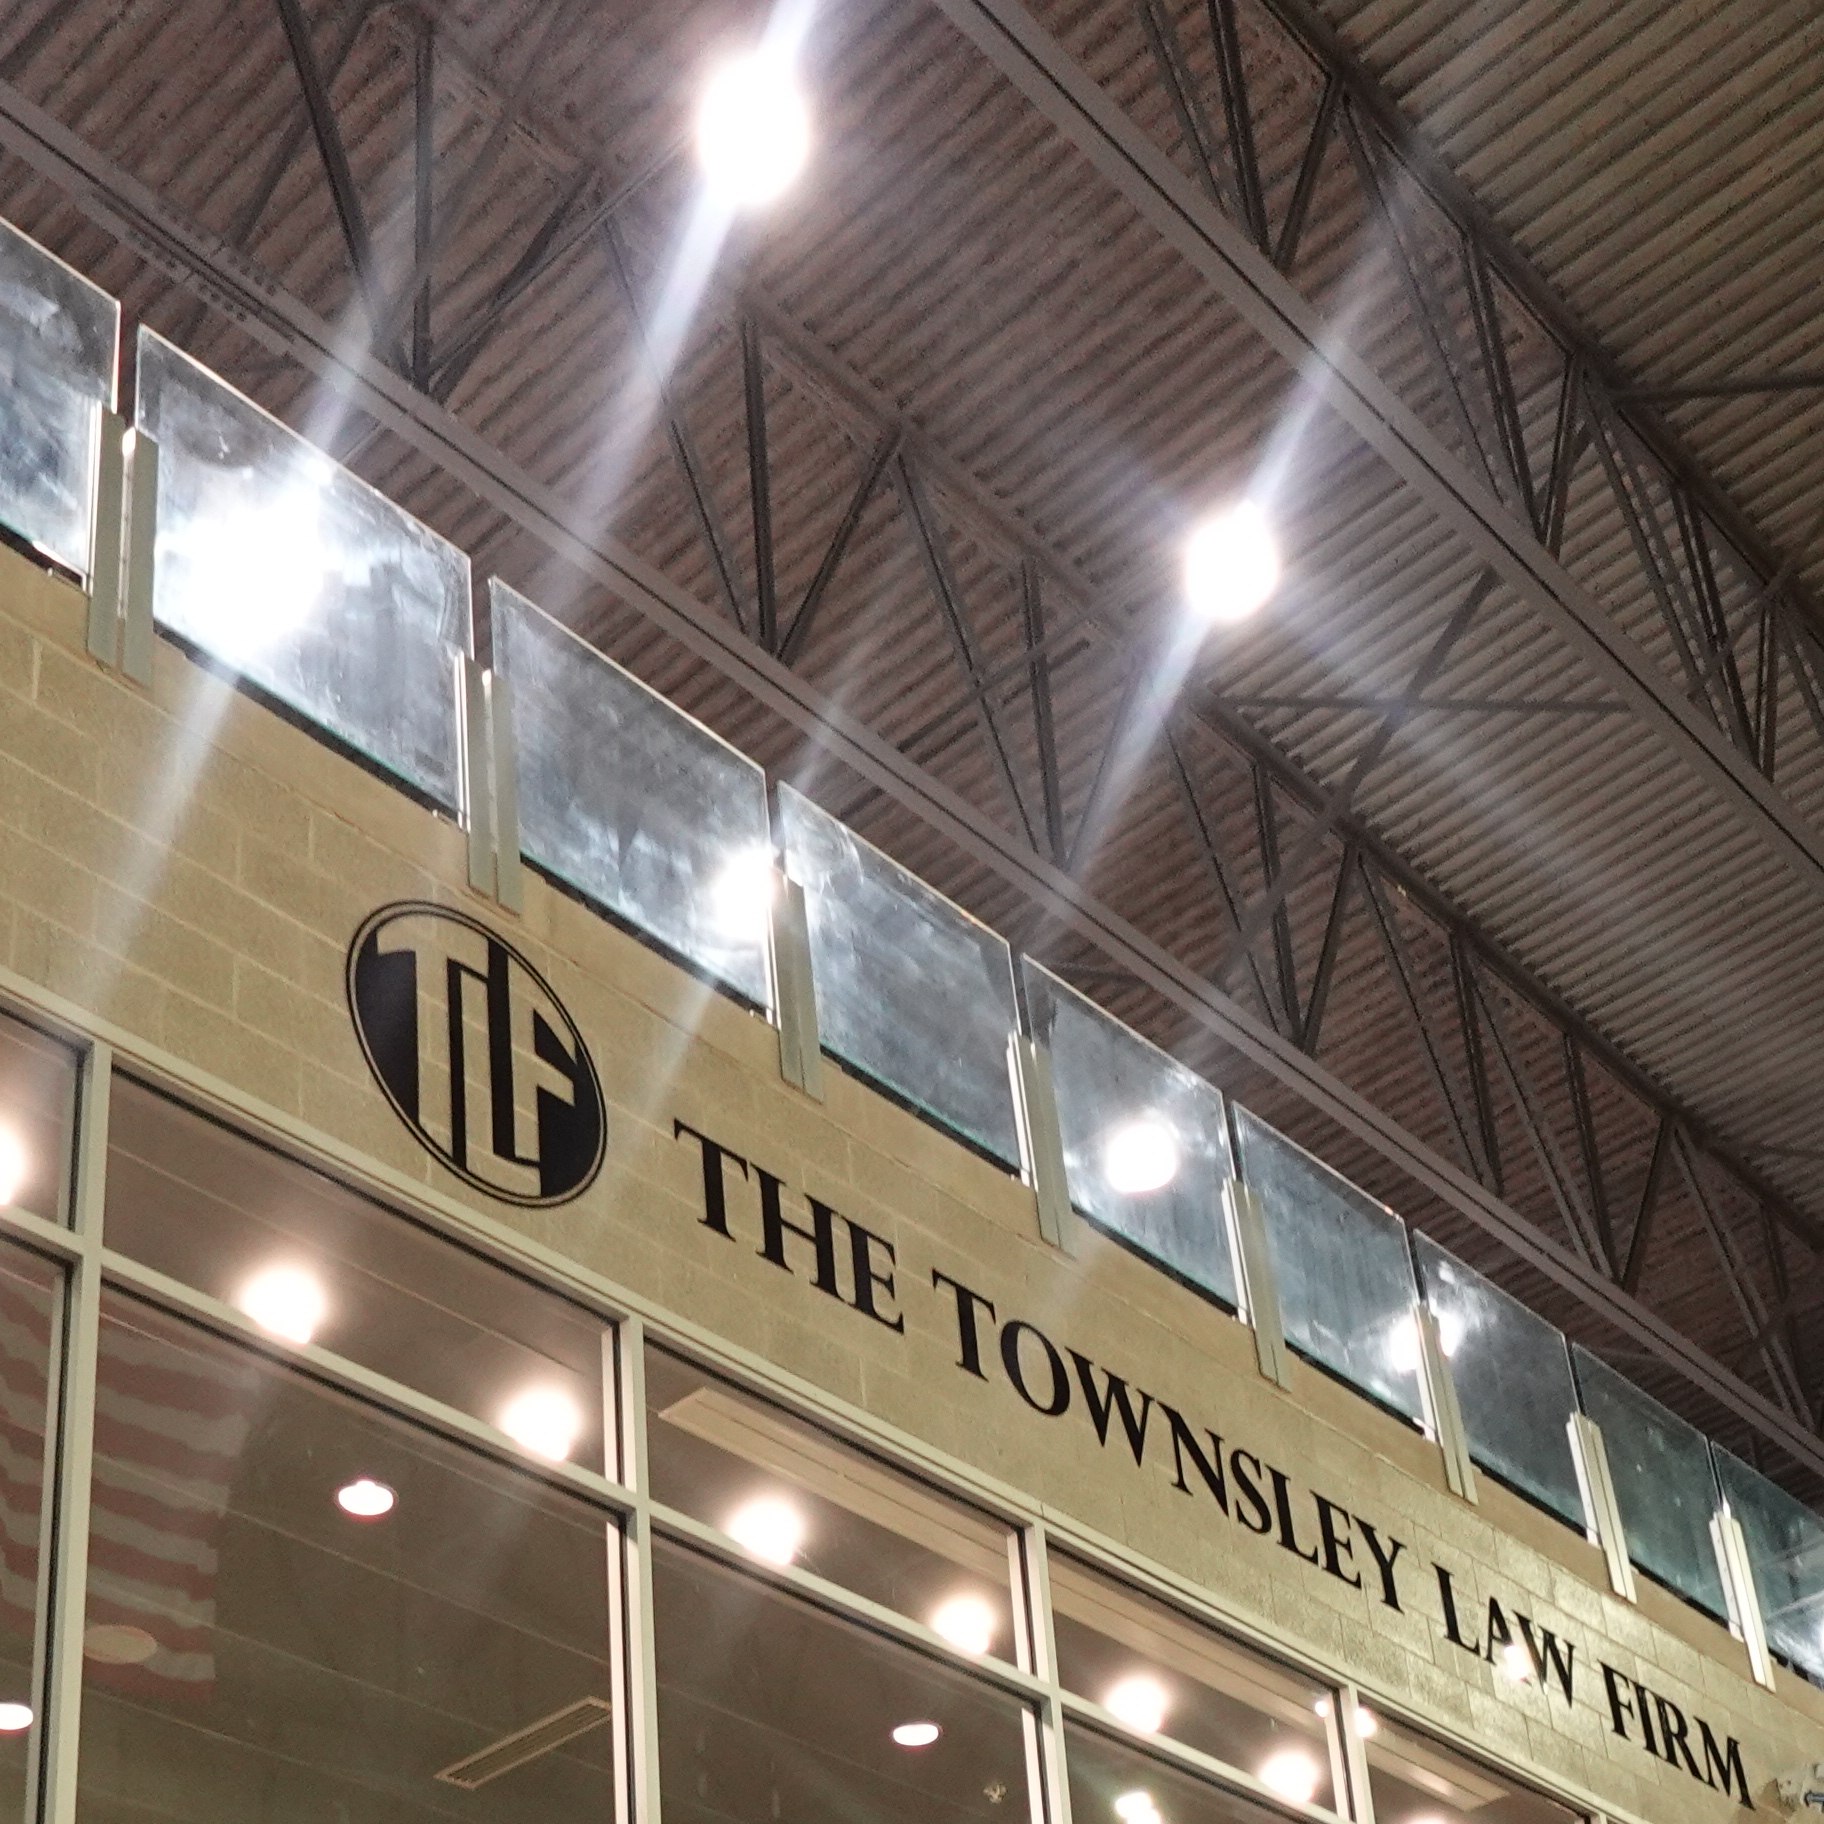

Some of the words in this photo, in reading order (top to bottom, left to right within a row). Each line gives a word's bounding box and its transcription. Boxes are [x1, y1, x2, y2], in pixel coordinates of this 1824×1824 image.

[673, 1117, 905, 1336] THE
[931, 1267, 1407, 1613] TOWNSLEY
[1431, 1561, 1576, 1709] LAW
[1598, 1659, 1757, 1811] FIRM
